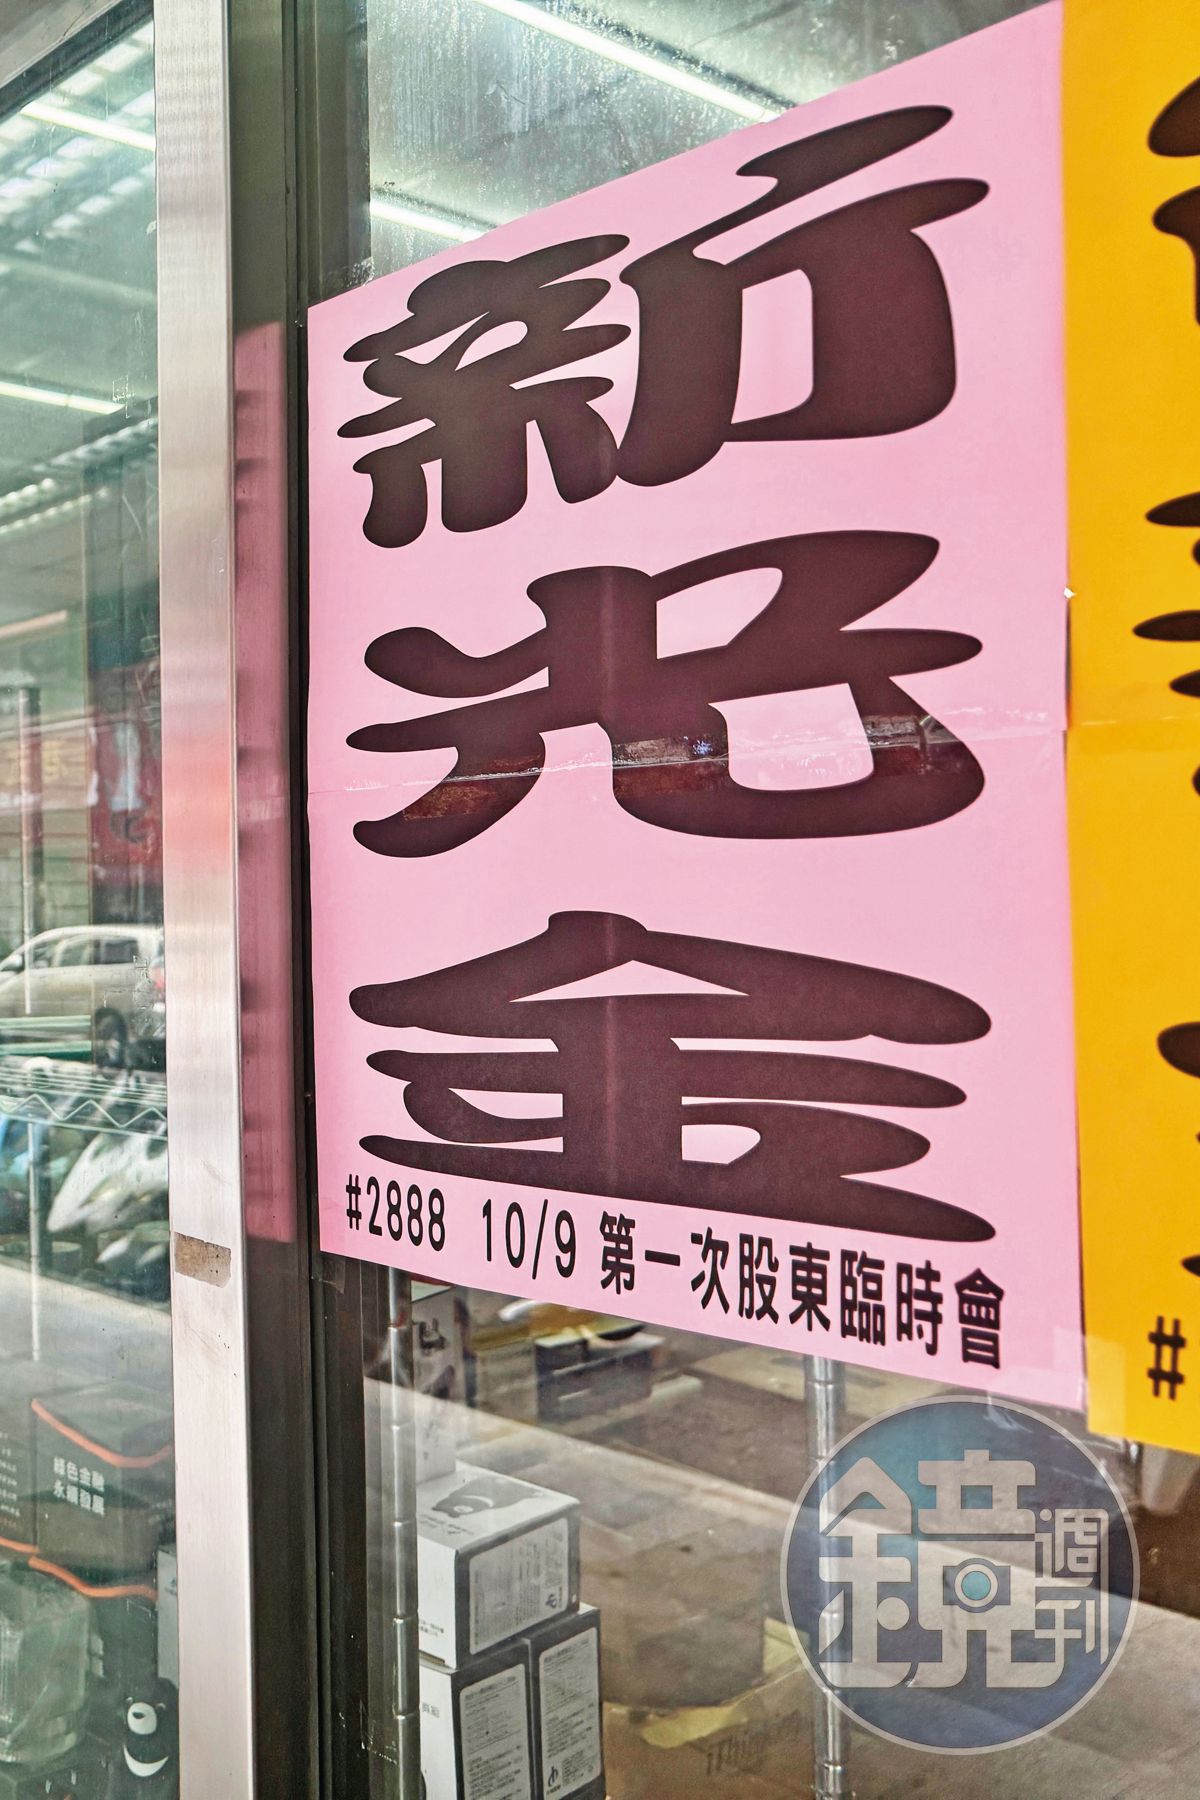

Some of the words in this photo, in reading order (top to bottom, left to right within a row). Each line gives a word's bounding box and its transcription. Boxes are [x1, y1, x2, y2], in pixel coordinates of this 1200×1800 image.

[337, 105, 996, 1241] 新光金
[345, 1173, 446, 1252] #2888
[482, 1197, 576, 1280] 10/9
[599, 1213, 1006, 1370] 第一次股東臨時會
